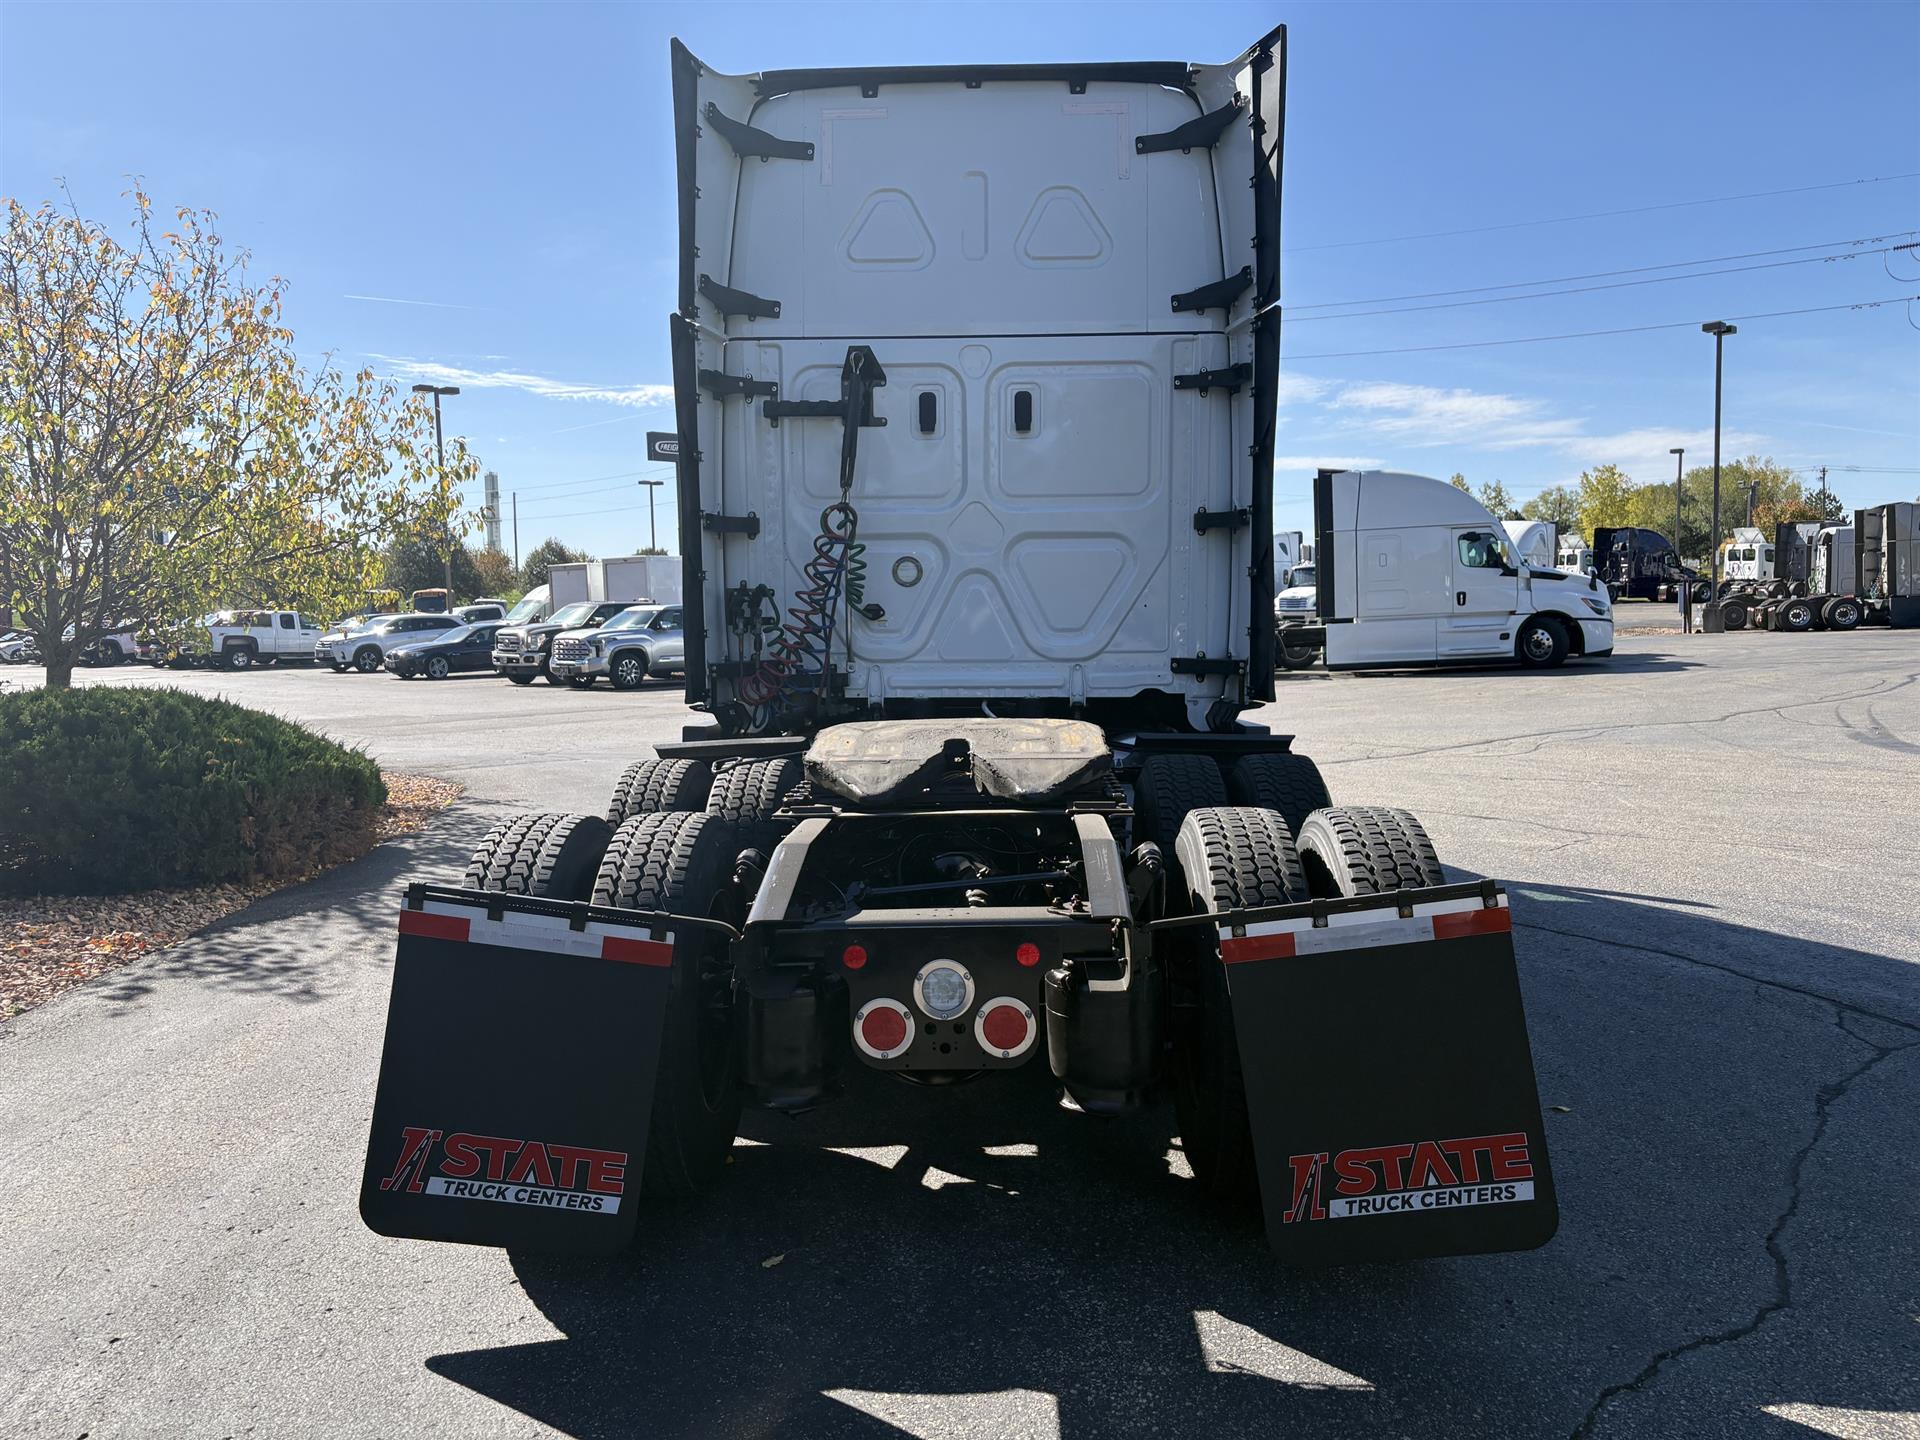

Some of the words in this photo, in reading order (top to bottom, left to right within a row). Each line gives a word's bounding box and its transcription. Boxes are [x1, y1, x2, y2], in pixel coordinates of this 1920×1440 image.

[440, 1132, 628, 1195] STATE
[1334, 1132, 1534, 1195] STATE
[443, 1180, 509, 1201] TRUCK
[514, 1188, 604, 1211] CENTERS
[1345, 1192, 1415, 1215] TRUCK
[1420, 1184, 1516, 1208] CENTERS
